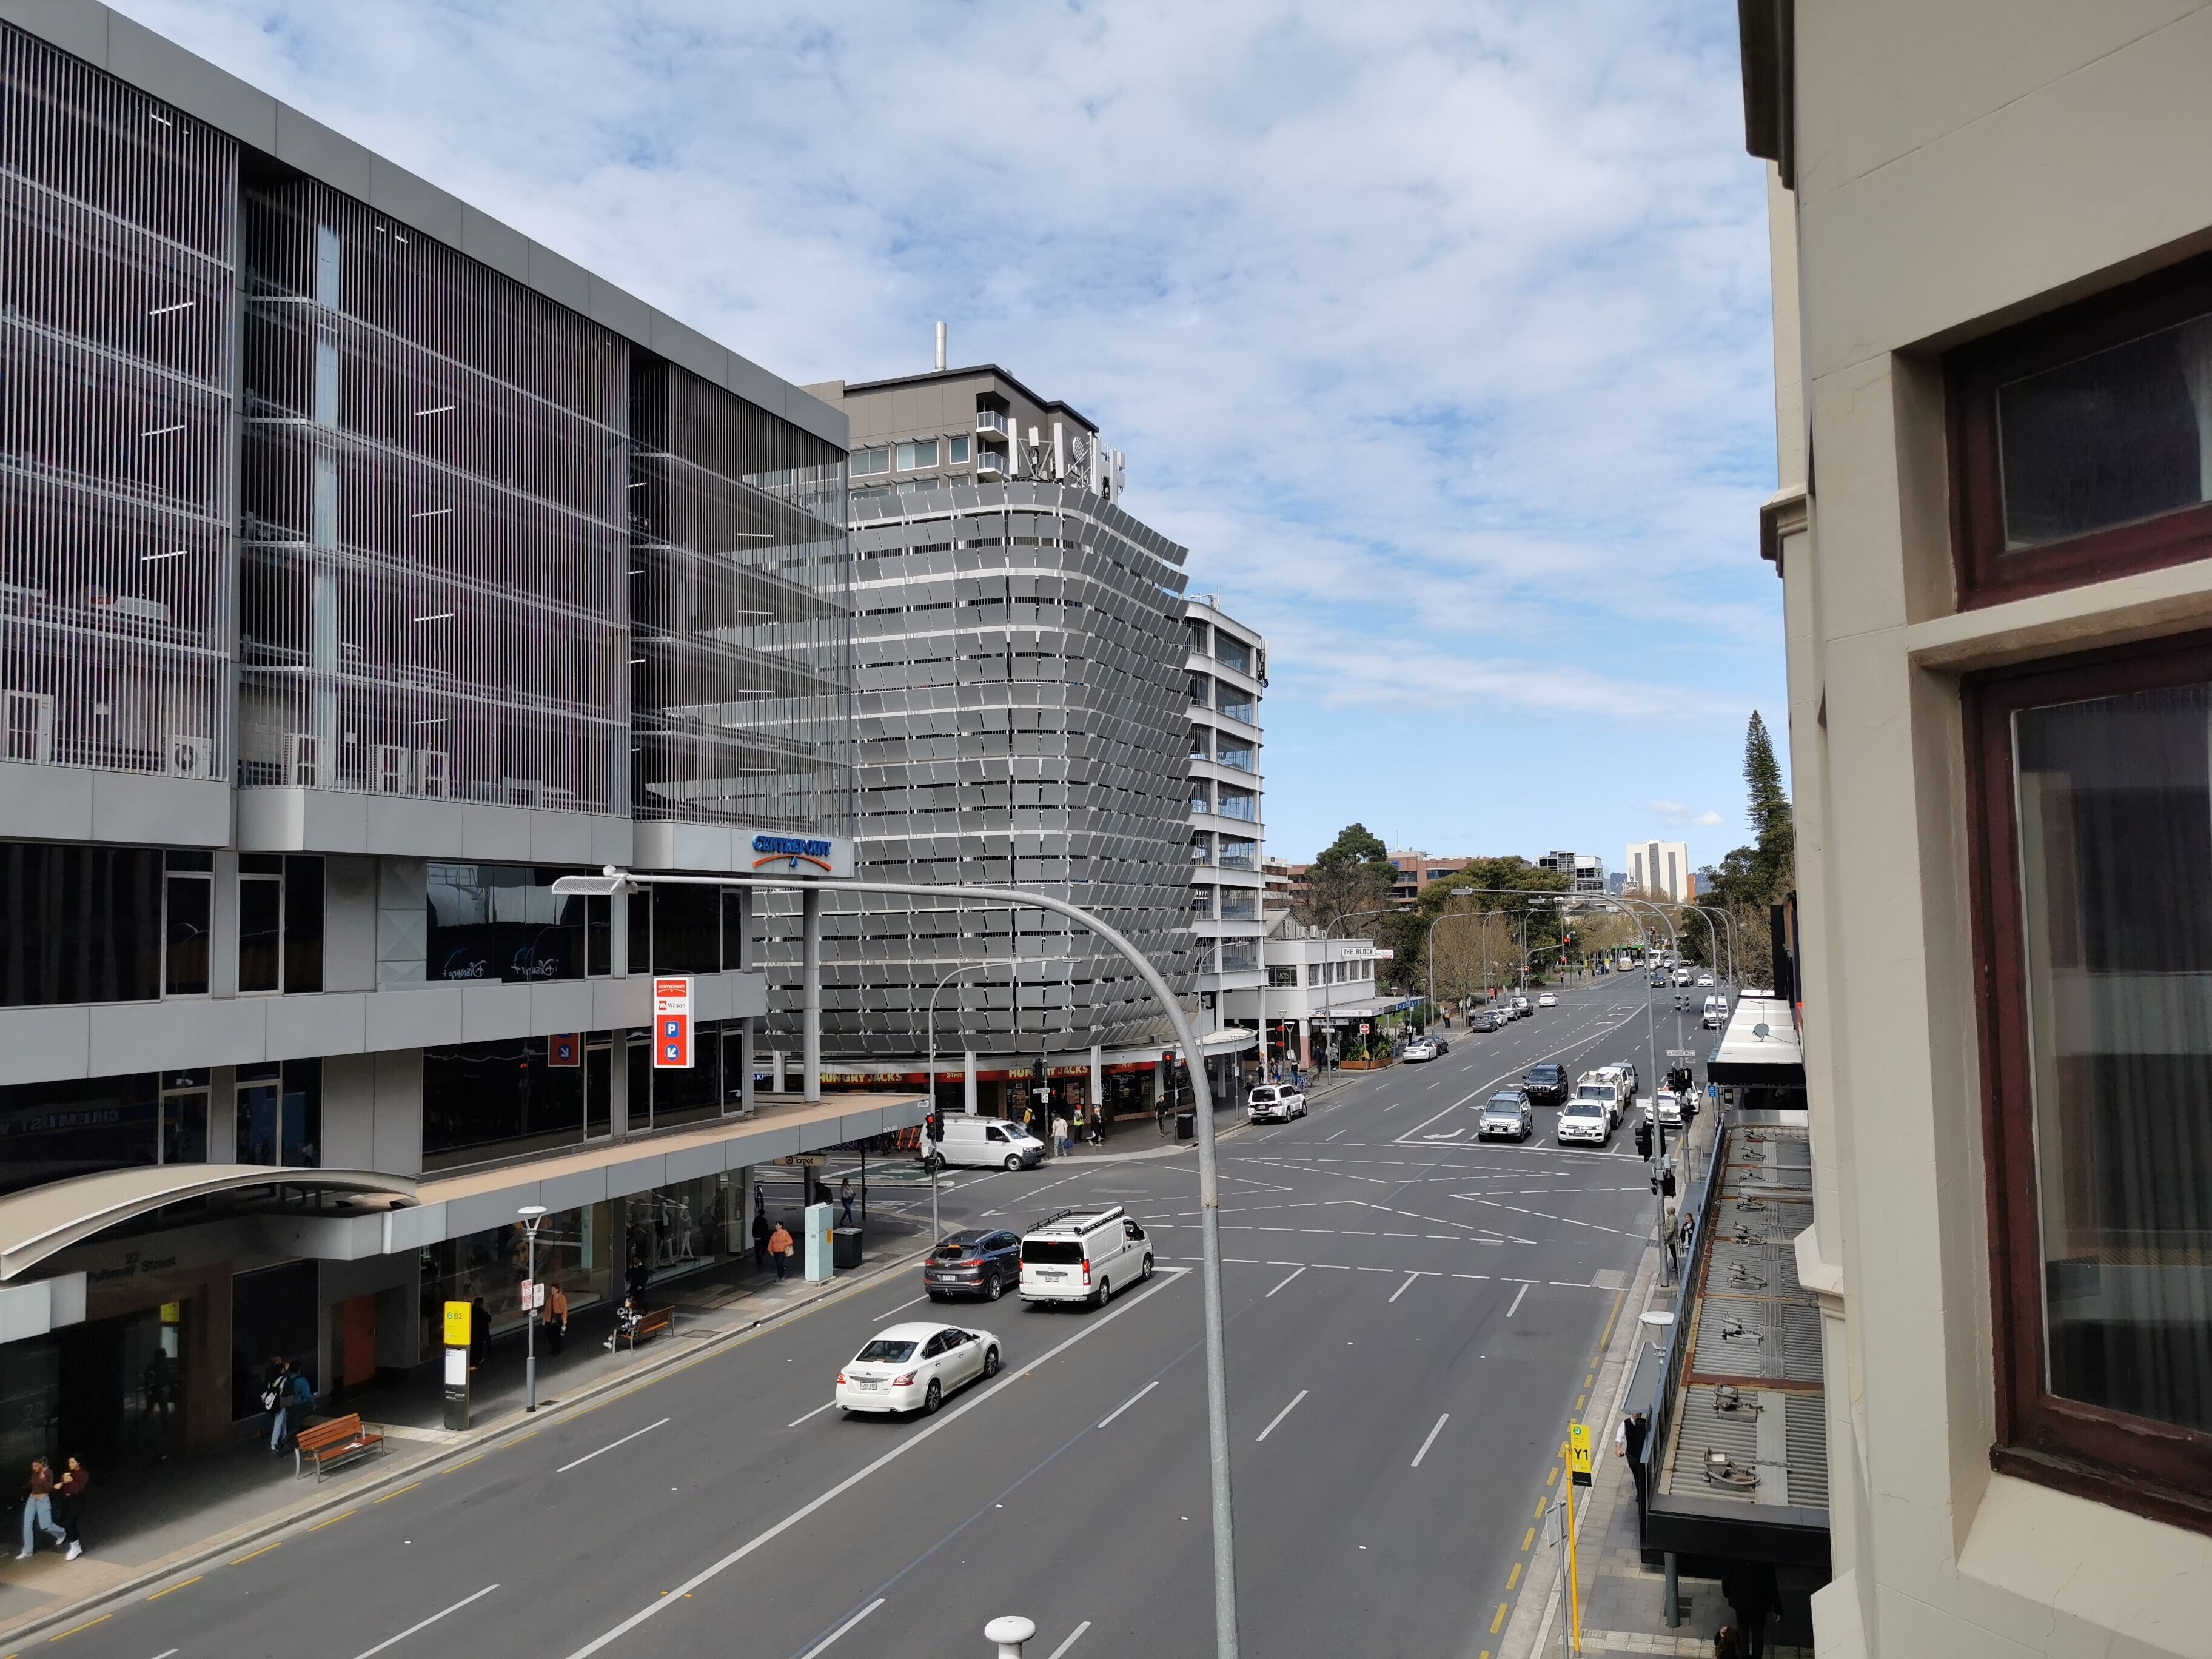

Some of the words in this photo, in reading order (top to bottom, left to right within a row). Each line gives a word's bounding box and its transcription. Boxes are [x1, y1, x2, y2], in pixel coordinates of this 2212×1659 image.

[753, 835, 832, 856] CENTREPOINT
[668, 1024, 676, 1035] P
[820, 1073, 865, 1083] HUNGRY
[794, 1156, 814, 1166] Target
[1574, 1447, 1589, 1461] Y1
